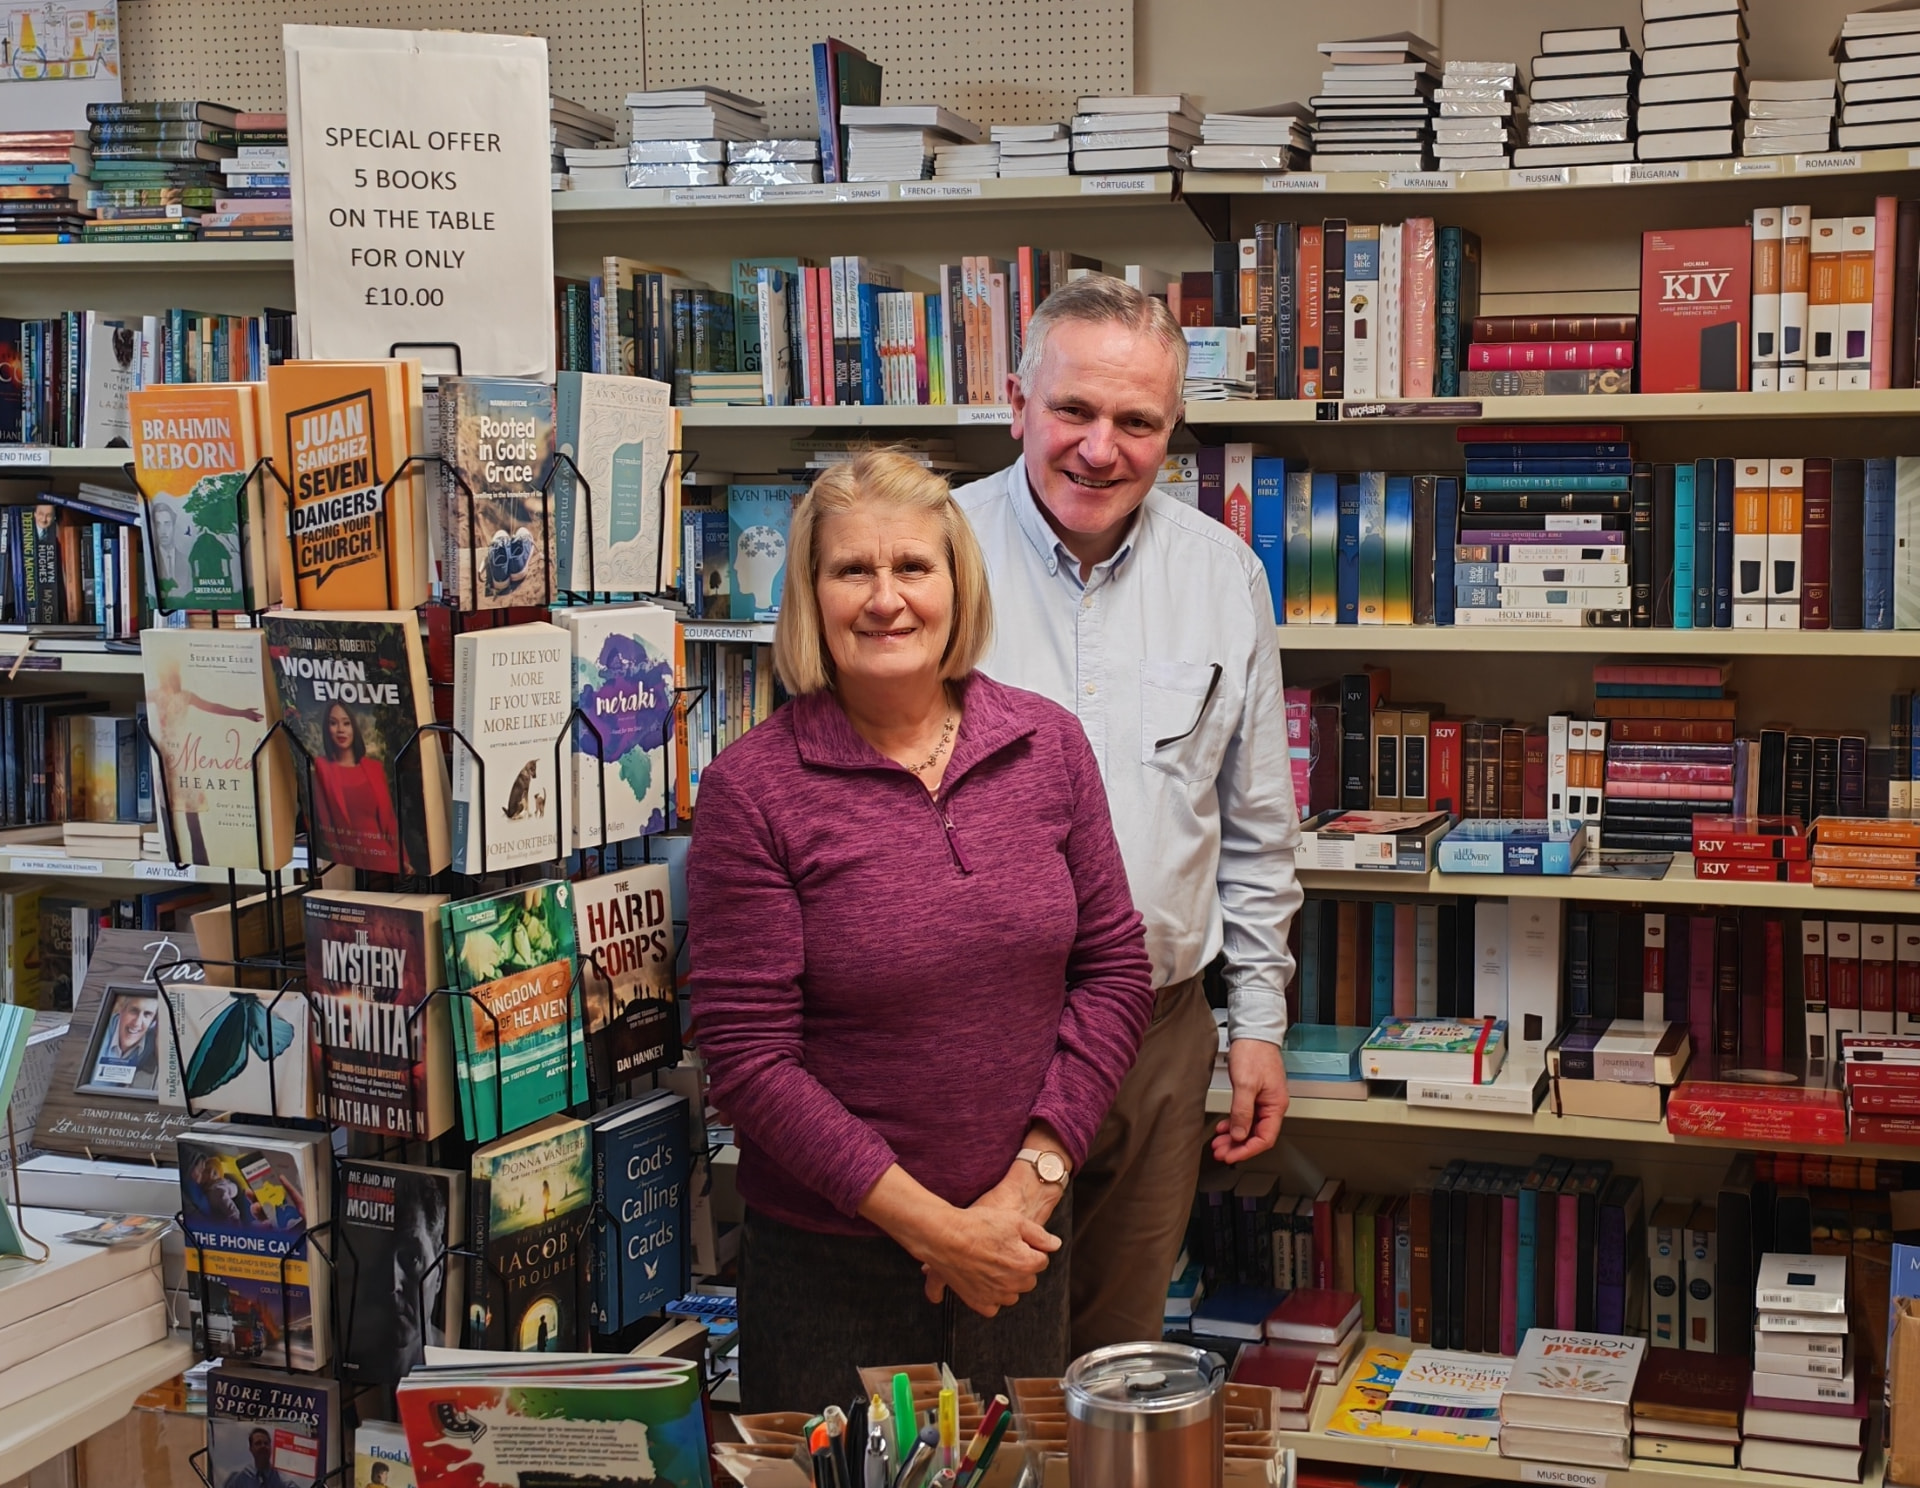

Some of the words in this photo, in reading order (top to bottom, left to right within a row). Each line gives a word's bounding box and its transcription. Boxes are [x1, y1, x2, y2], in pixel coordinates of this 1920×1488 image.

[325, 127, 420, 150] SPECIAL
[428, 131, 501, 152] OFFER
[1805, 158, 1856, 168] ROMANIAN
[354, 169, 368, 188] 5
[376, 169, 457, 190] BOOKS
[1403, 178, 1449, 188] UKRAINIAN
[1525, 173, 1562, 184] RUSSIAN
[1630, 169, 1680, 179] BULGARIAN
[851, 189, 881, 199] SPANISH
[907, 186, 935, 195] FRENCH
[942, 186, 973, 195] TURKISH
[1096, 181, 1145, 190] PORTUGUESE
[1271, 180, 1319, 189] LITHUANIAN
[329, 208, 366, 228] ON
[373, 209, 419, 228] THE
[426, 210, 496, 230] TABLE
[351, 248, 397, 267] FOR
[405, 249, 465, 268] ONLY
[1354, 253, 1370, 262] Holy
[1354, 260, 1371, 268] Bible
[1280, 275, 1291, 310] HOLY
[1662, 272, 1730, 301] KJV
[364, 287, 444, 307] £10.00
[1260, 286, 1273, 311] Holy
[1260, 312, 1272, 344] Bible
[1280, 311, 1291, 352] BIBLE
[971, 412, 995, 420] SARAH
[142, 417, 231, 441] BRAHMIN
[296, 403, 364, 451] JUAN
[480, 415, 535, 439] Rooted
[18, 453, 42, 462] TIMES
[141, 442, 236, 470] REBORN
[297, 436, 368, 473] SANCHEZ
[479, 440, 493, 461] in
[496, 439, 537, 461] God's
[1231, 456, 1246, 464] KJV
[298, 458, 368, 500] SEVEN
[485, 461, 533, 483] Grace
[1257, 478, 1279, 486] HOLY
[1257, 488, 1279, 496] BIBLE
[1502, 478, 1529, 487] HOLY
[1534, 478, 1564, 487] BIBLE
[732, 489, 760, 501] EVEN
[294, 489, 378, 531] DANGERS
[1230, 499, 1238, 529] STUDY
[302, 523, 340, 545] FACING
[343, 515, 371, 535] YOUR
[301, 532, 372, 568] CHURCH
[38, 544, 47, 584] HUGHES
[47, 544, 55, 583] SELWYN
[24, 554, 36, 602] MOMENTS
[1499, 611, 1524, 619] HOLY
[684, 628, 753, 638] COURAGEMENT
[289, 636, 312, 650] SARAH
[314, 637, 338, 652] JAKES
[339, 639, 376, 653] ROBERTS
[491, 652, 508, 667] I'D
[511, 650, 536, 666] LIKE
[538, 648, 561, 665] YOU
[279, 656, 366, 682] WOMAN
[510, 671, 544, 687] MORE
[312, 681, 400, 705] EVOLVE
[489, 696, 502, 711] IF
[503, 694, 530, 710] YOU
[531, 690, 562, 707] WERE
[596, 681, 657, 716] meraki
[1348, 692, 1362, 700] KJV
[483, 715, 521, 734] MORE
[523, 713, 548, 730] LIKE
[549, 711, 566, 727] ME
[1434, 728, 1456, 738] KJV
[179, 776, 241, 791] HEART
[607, 821, 625, 832] Allen
[486, 839, 515, 857] JOHN
[1699, 840, 1726, 851] KJV
[146, 867, 162, 876] AW
[163, 867, 189, 878] TOZER
[1702, 863, 1730, 873] KJV
[614, 881, 629, 894] THE
[586, 888, 665, 943] HARD
[354, 930, 369, 945] THE
[321, 939, 407, 990] MYSTERY
[591, 929, 668, 981] CORPS
[361, 985, 376, 1001] THE
[483, 978, 542, 1022] KINGDOM
[501, 1015, 512, 1029] OF
[513, 998, 567, 1029] HEAVEN
[313, 990, 424, 1063] SHEMITAH
[617, 1057, 631, 1073] DAI
[632, 1043, 664, 1067] HANKEY
[1602, 1058, 1645, 1069] Journaling
[169, 1039, 177, 1098] TRANSFORMING
[378, 1068, 402, 1080] MYSTERY
[1613, 1069, 1634, 1077] Bible
[81, 1108, 109, 1119] STAND
[109, 1111, 131, 1121] FIRM
[144, 1112, 161, 1124] the
[1689, 1103, 1726, 1120] Lighting
[49, 1117, 72, 1134] Let
[71, 1125, 86, 1133] ALL
[87, 1125, 107, 1135] THAT
[108, 1127, 126, 1138] YOU
[126, 1130, 140, 1139] DO
[1679, 1118, 1699, 1132] Way
[1702, 1121, 1727, 1132] Home
[501, 1155, 542, 1177] DONNA
[543, 1138, 585, 1163] VANLIERE
[627, 1145, 674, 1181] God's
[348, 1171, 361, 1183] ME
[362, 1174, 381, 1187] AND
[382, 1176, 397, 1189] MY
[347, 1183, 395, 1202] BLEEDING
[621, 1182, 680, 1223] Calling
[346, 1199, 395, 1223] MOUTH
[192, 1231, 216, 1246] THE
[220, 1234, 265, 1252] PHONE
[628, 1220, 674, 1261] Cards
[507, 1252, 576, 1292] TROUBLE
[1542, 1334, 1636, 1350] MISSION
[1544, 1343, 1627, 1359] praise
[1421, 1365, 1509, 1385] Worship
[1430, 1361, 1509, 1376] Easy-to-play
[1406, 1369, 1504, 1392] Songs
[215, 1380, 262, 1401] MORE
[270, 1389, 316, 1410] THAN
[215, 1396, 320, 1427] SPECTATORS
[370, 1445, 402, 1462] Flood
[1536, 1469, 1565, 1481] MUSIC
[1566, 1472, 1597, 1484] BOOKS
